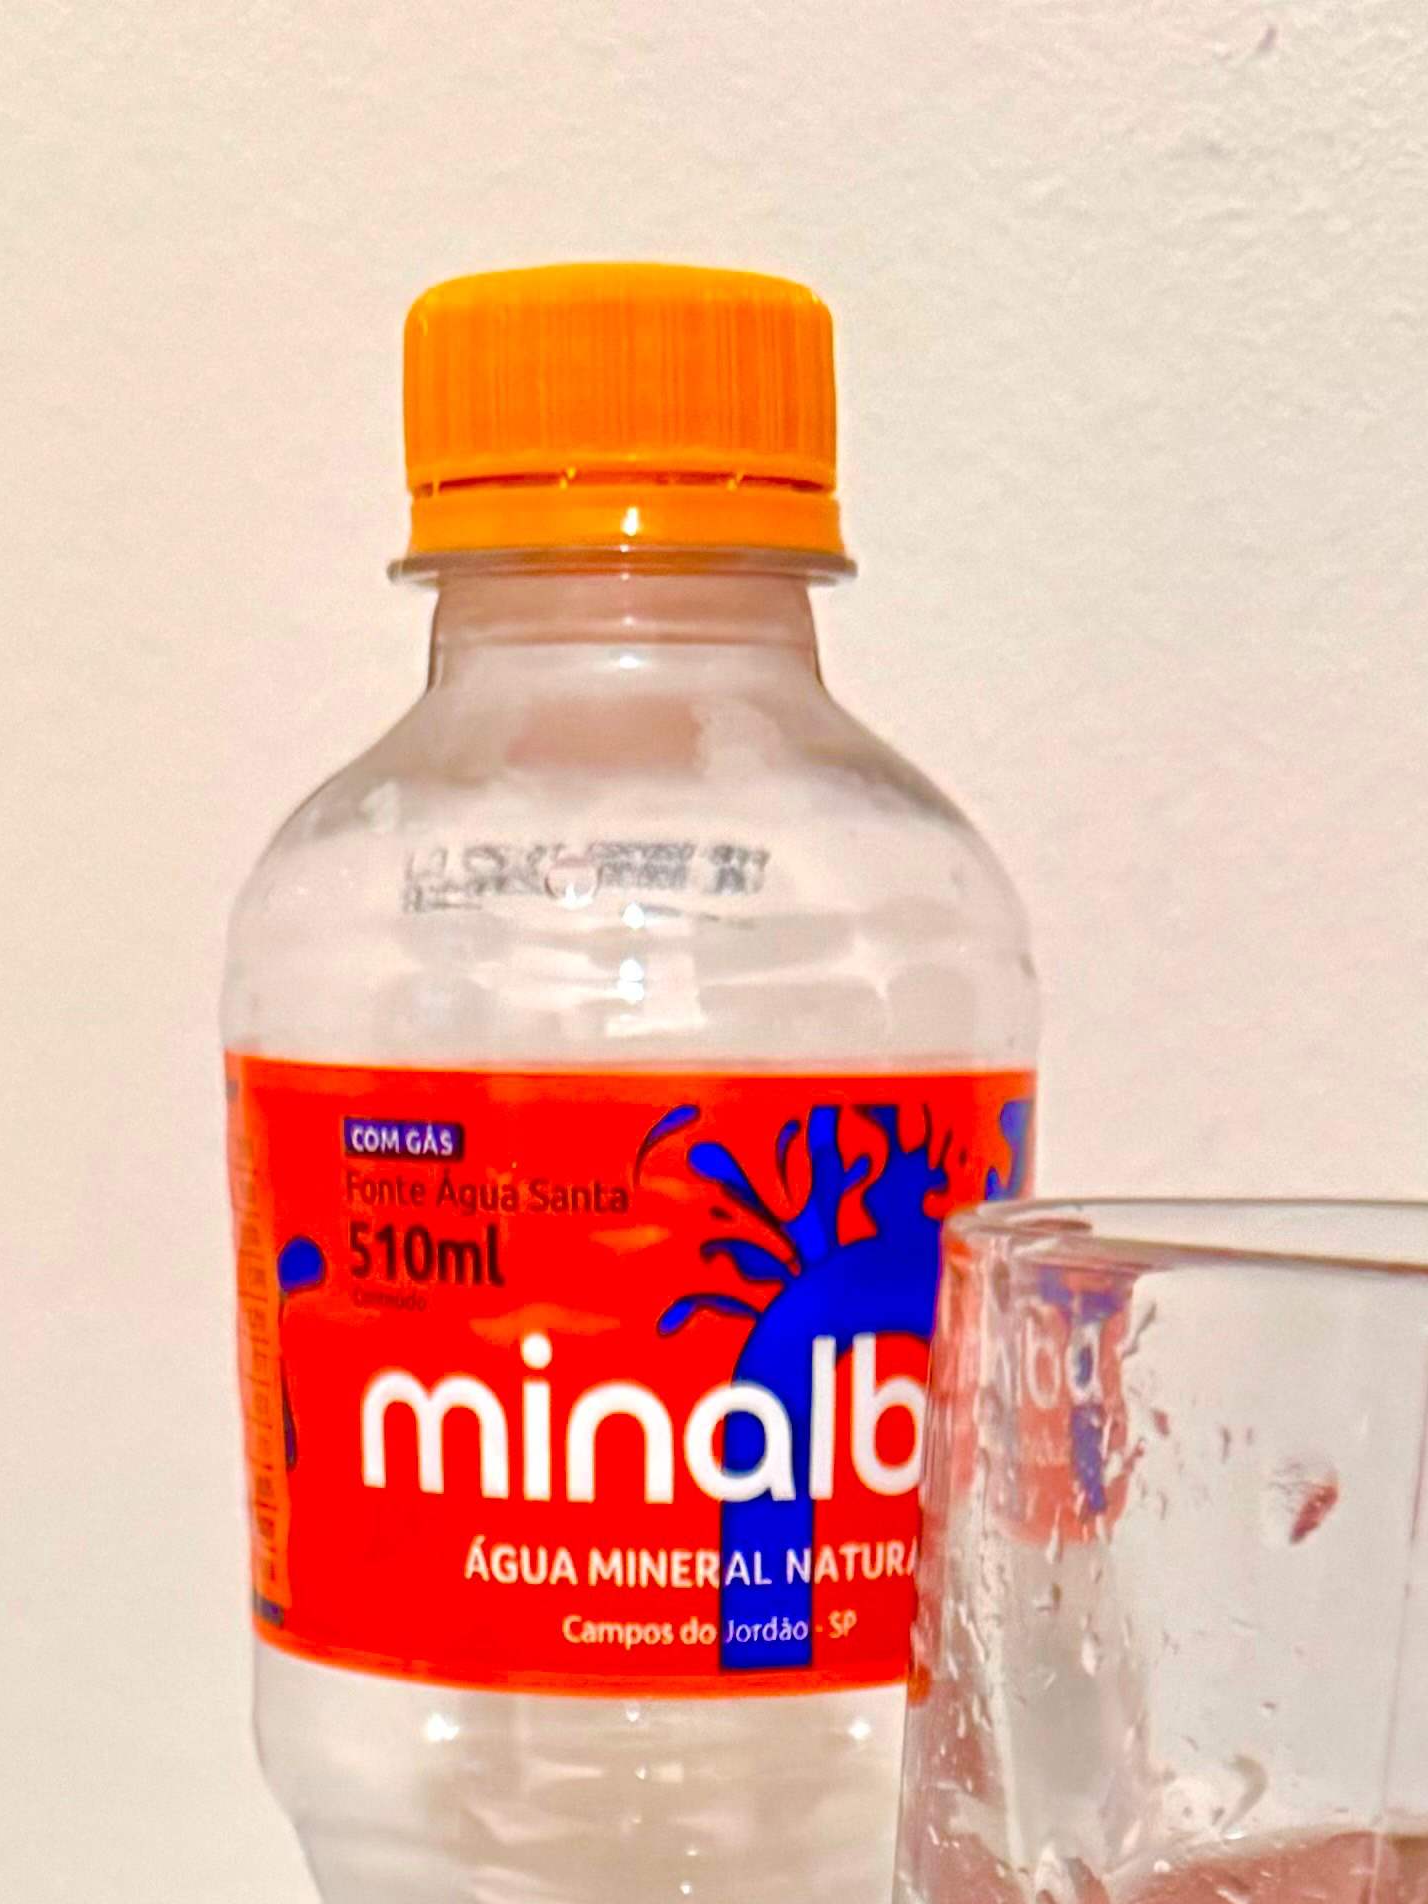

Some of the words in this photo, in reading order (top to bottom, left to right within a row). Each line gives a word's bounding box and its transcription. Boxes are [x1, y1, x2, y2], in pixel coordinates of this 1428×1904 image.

[351, 1124, 400, 1153] COM
[406, 1122, 453, 1156] GÁS
[346, 1171, 426, 1206] Fonte
[437, 1171, 518, 1216] Água
[528, 1177, 628, 1214] Santa
[349, 1220, 505, 1287] 510ml
[464, 1535, 578, 1585] ÁGUA
[588, 1547, 772, 1589] MINERAL
[562, 1615, 674, 1650] Campos
[680, 1615, 716, 1645] do
[725, 1613, 808, 1643] Jordão
[829, 1610, 857, 1638] SP
